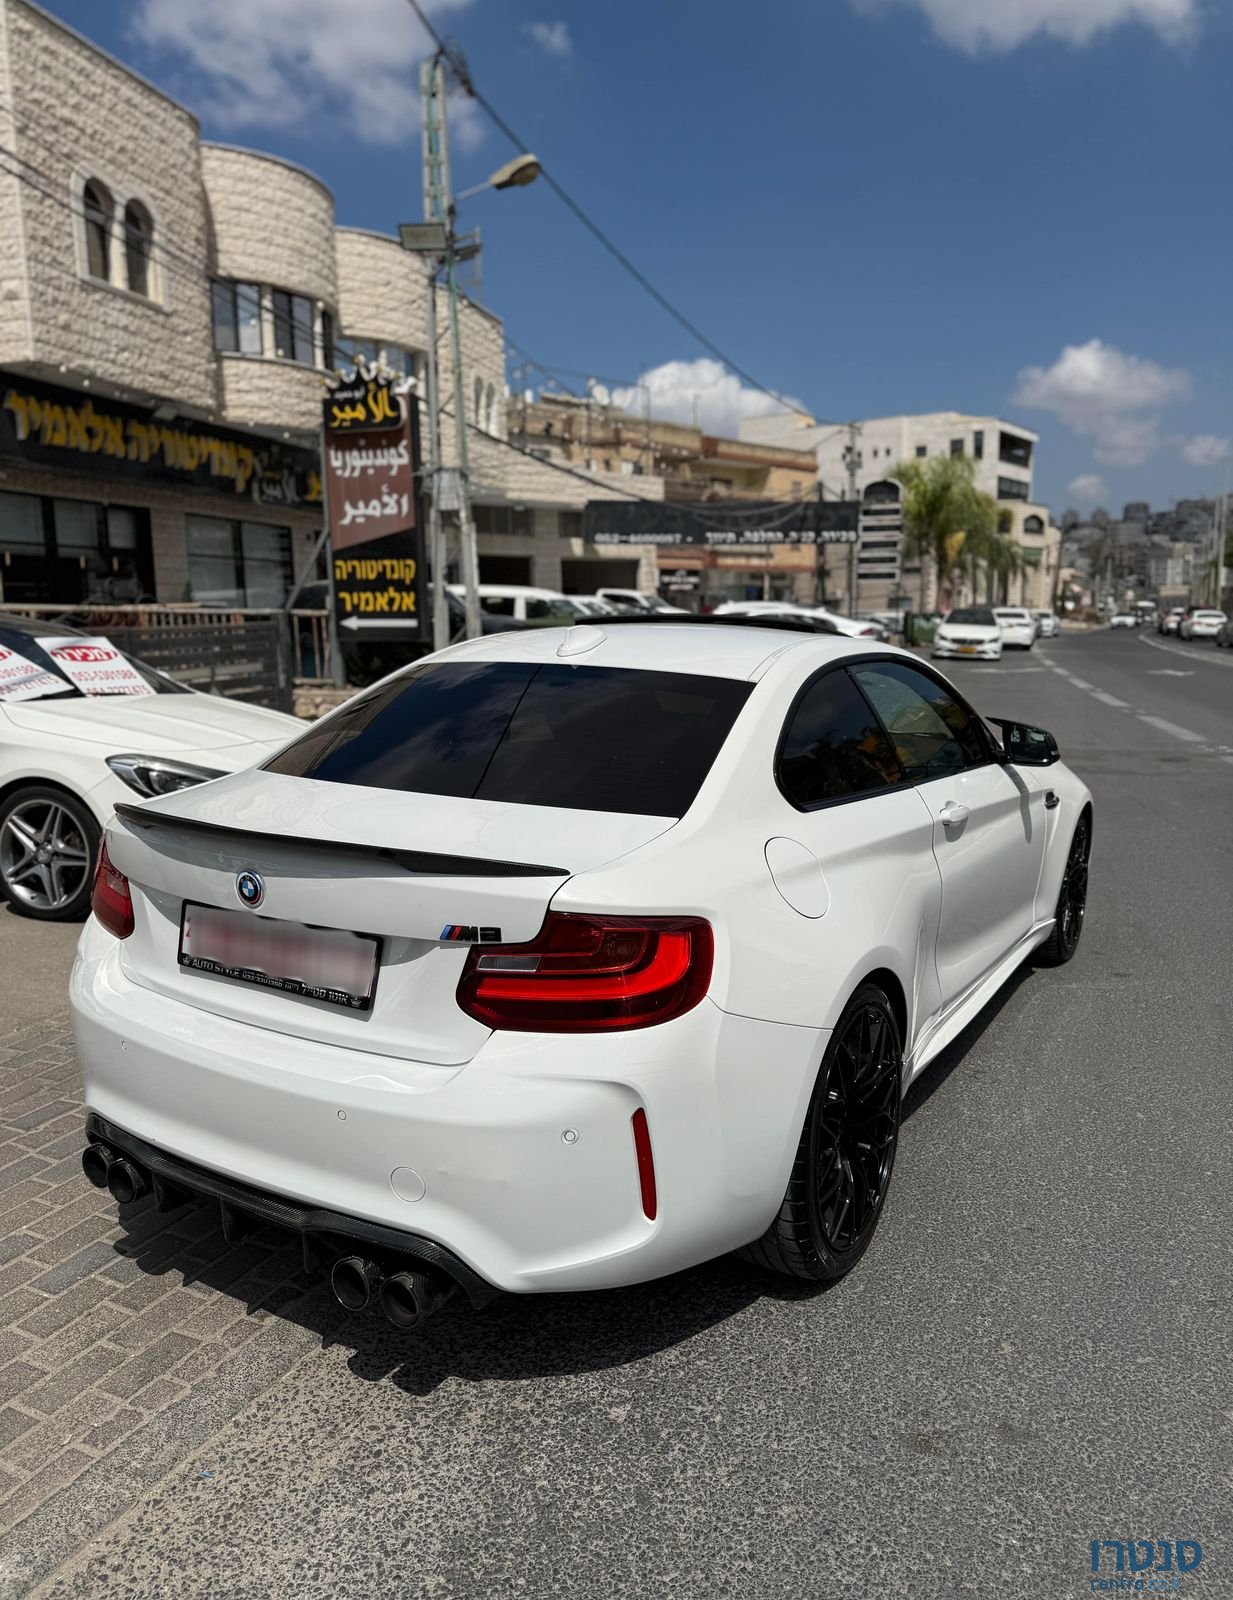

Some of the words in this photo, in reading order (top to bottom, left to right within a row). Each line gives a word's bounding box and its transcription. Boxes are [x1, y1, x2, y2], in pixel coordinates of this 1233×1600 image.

[3, 389, 126, 459] אלאמיר
[126, 419, 254, 493] קונדיטוריה
[338, 484, 409, 526] الأمير
[334, 559, 416, 585] קונדיטוריה
[338, 586, 416, 612] אלאמיר
[192, 959, 214, 970] AUTO
[328, 991, 349, 1004] אוטו
